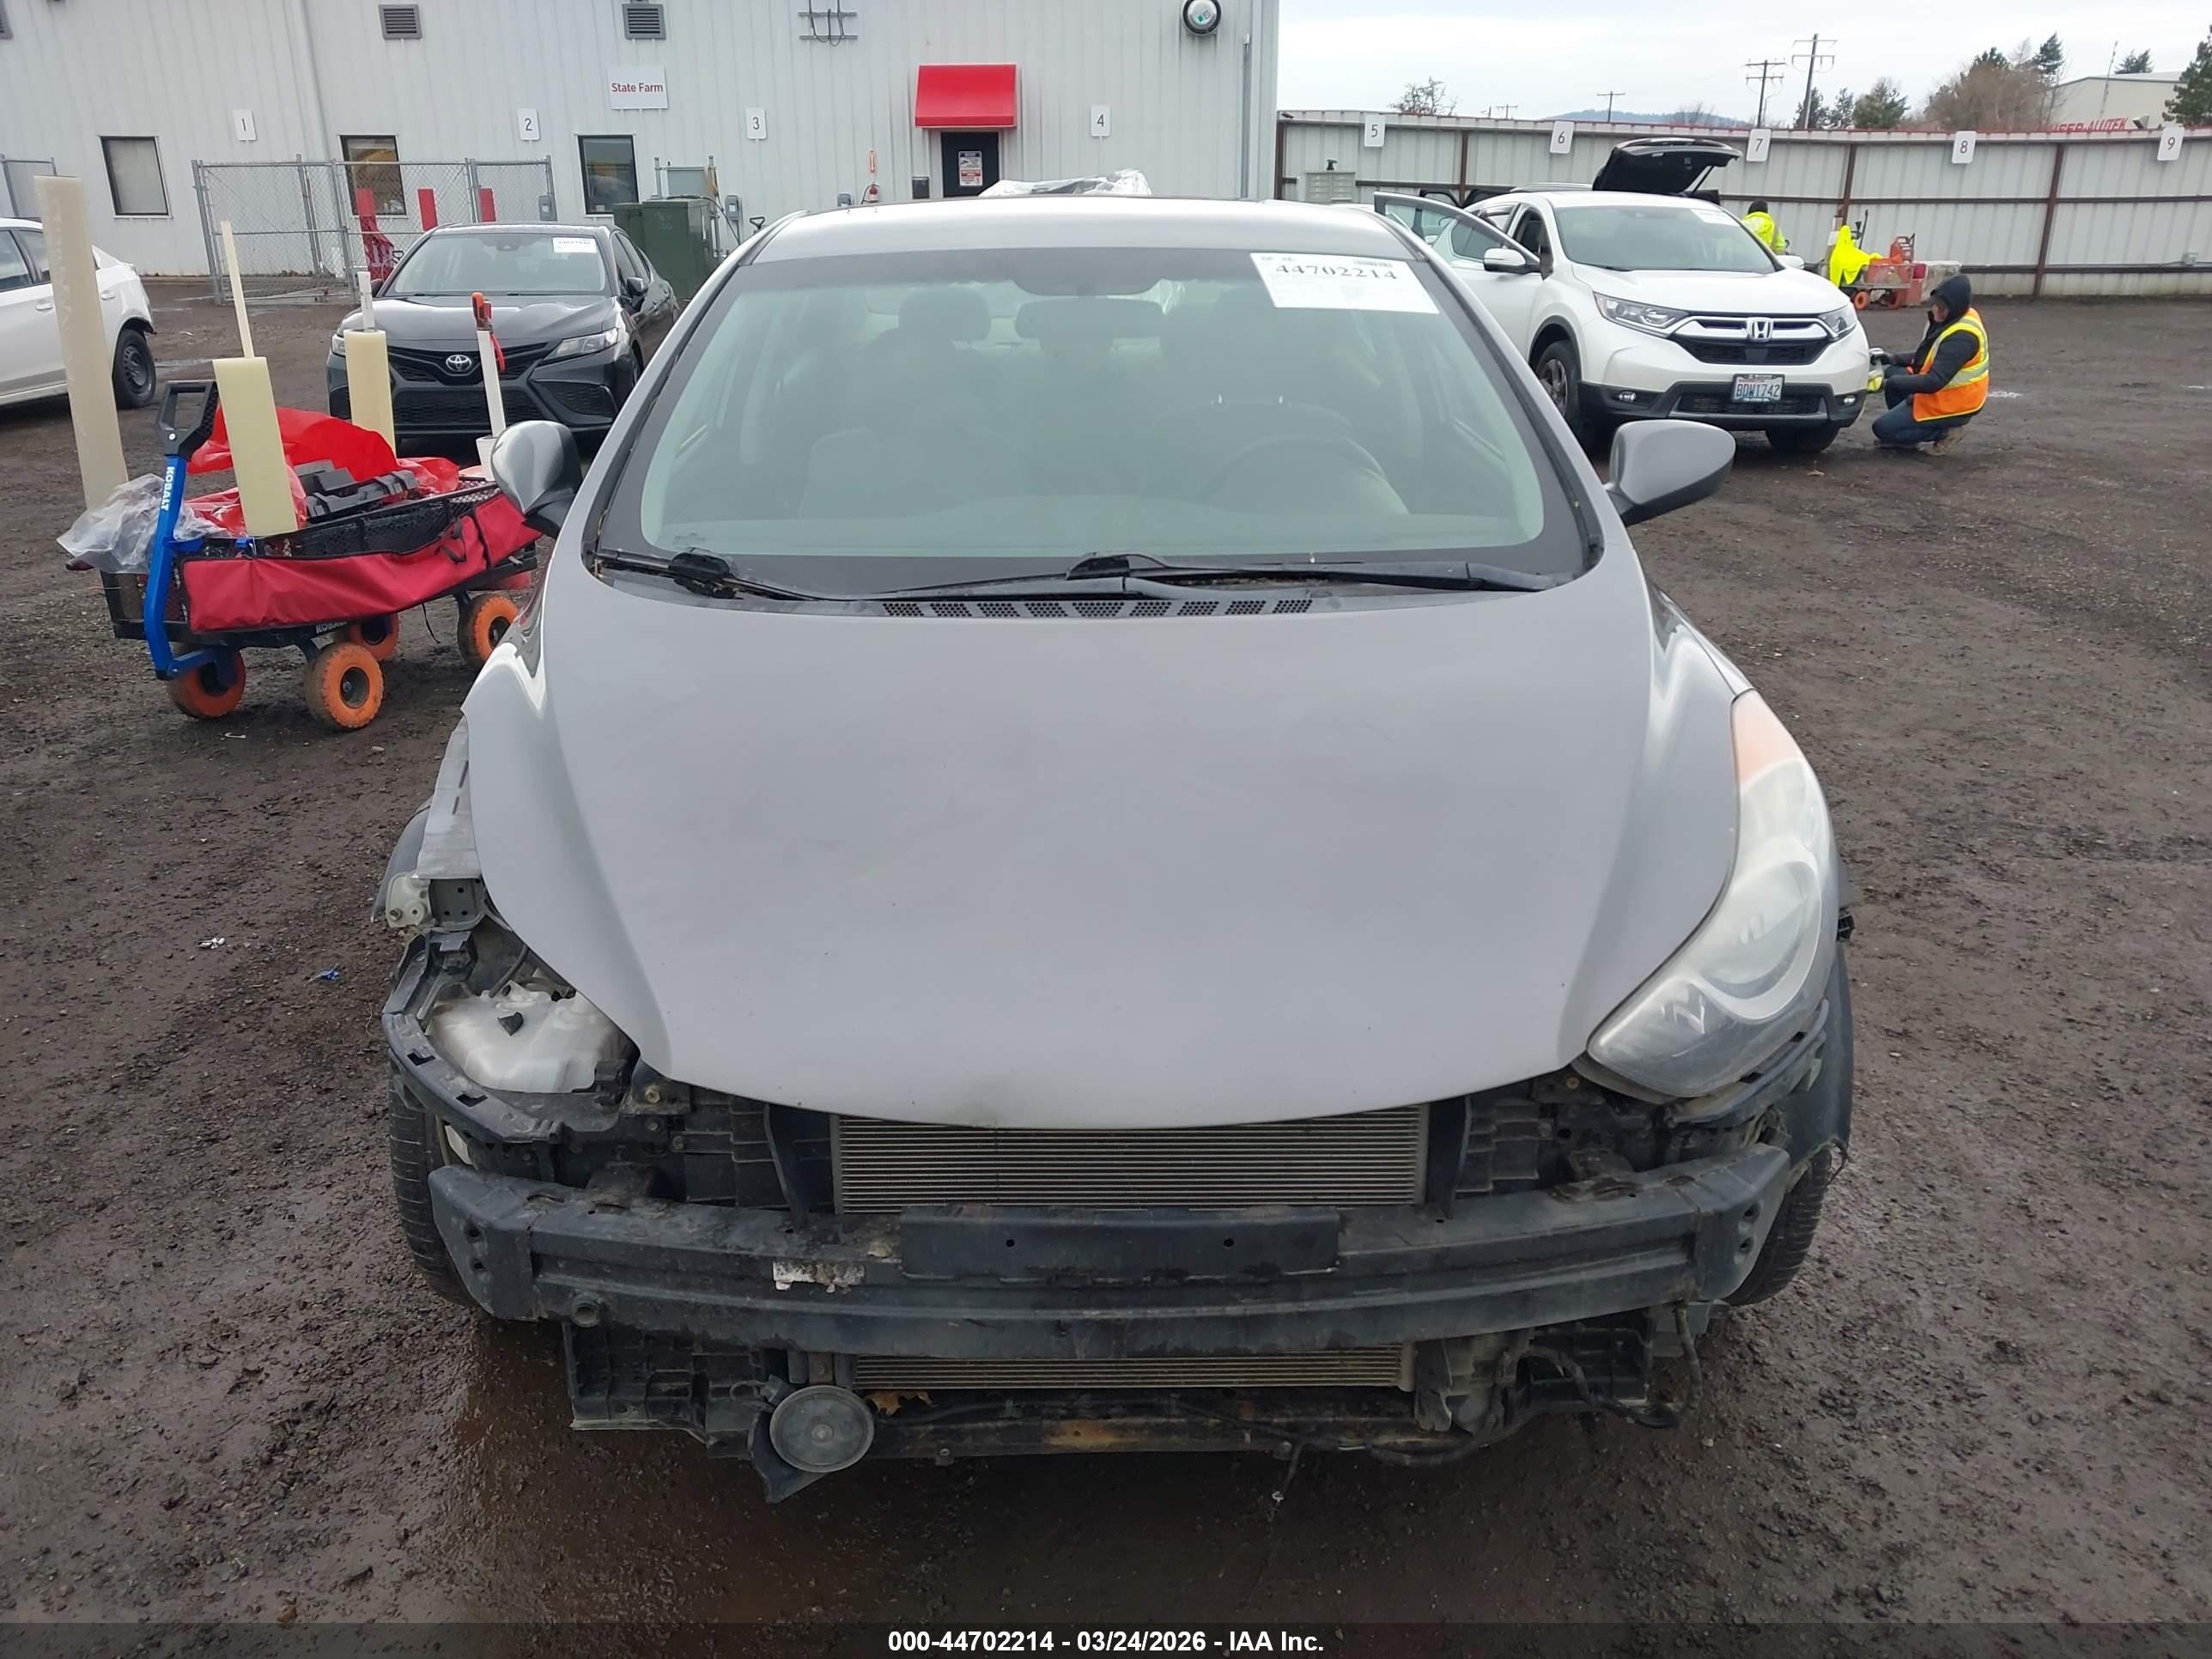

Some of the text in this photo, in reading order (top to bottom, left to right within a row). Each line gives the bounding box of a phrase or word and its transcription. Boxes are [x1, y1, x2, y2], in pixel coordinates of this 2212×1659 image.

[611, 82, 664, 93] State Farm
[241, 118, 246, 132] 1
[524, 117, 533, 131] 2
[751, 116, 760, 131] 3
[1096, 113, 1104, 128] 4
[1370, 124, 1379, 137] 5
[1557, 131, 1565, 144] 6
[1754, 137, 1764, 152] 7
[1960, 140, 1969, 155] 8
[2167, 137, 2177, 151] 9
[1275, 264, 1398, 280] 44702214
[161, 466, 175, 511] KOBALT
